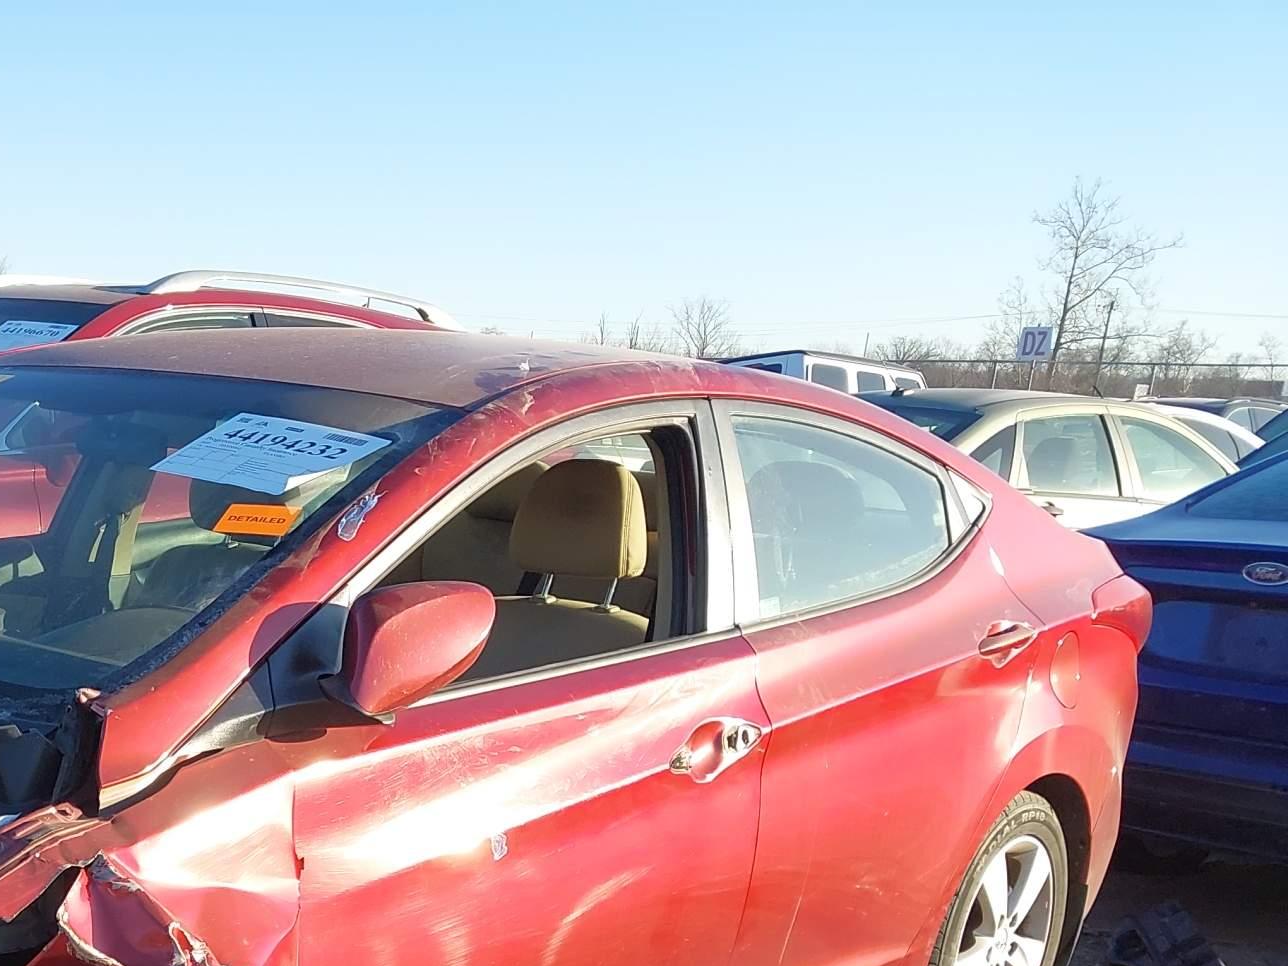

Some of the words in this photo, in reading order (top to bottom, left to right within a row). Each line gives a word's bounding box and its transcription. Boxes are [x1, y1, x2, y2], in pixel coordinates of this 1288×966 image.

[1022, 331, 1048, 356] DZ
[224, 428, 348, 460] 44194232
[227, 514, 286, 524] DETAILED
